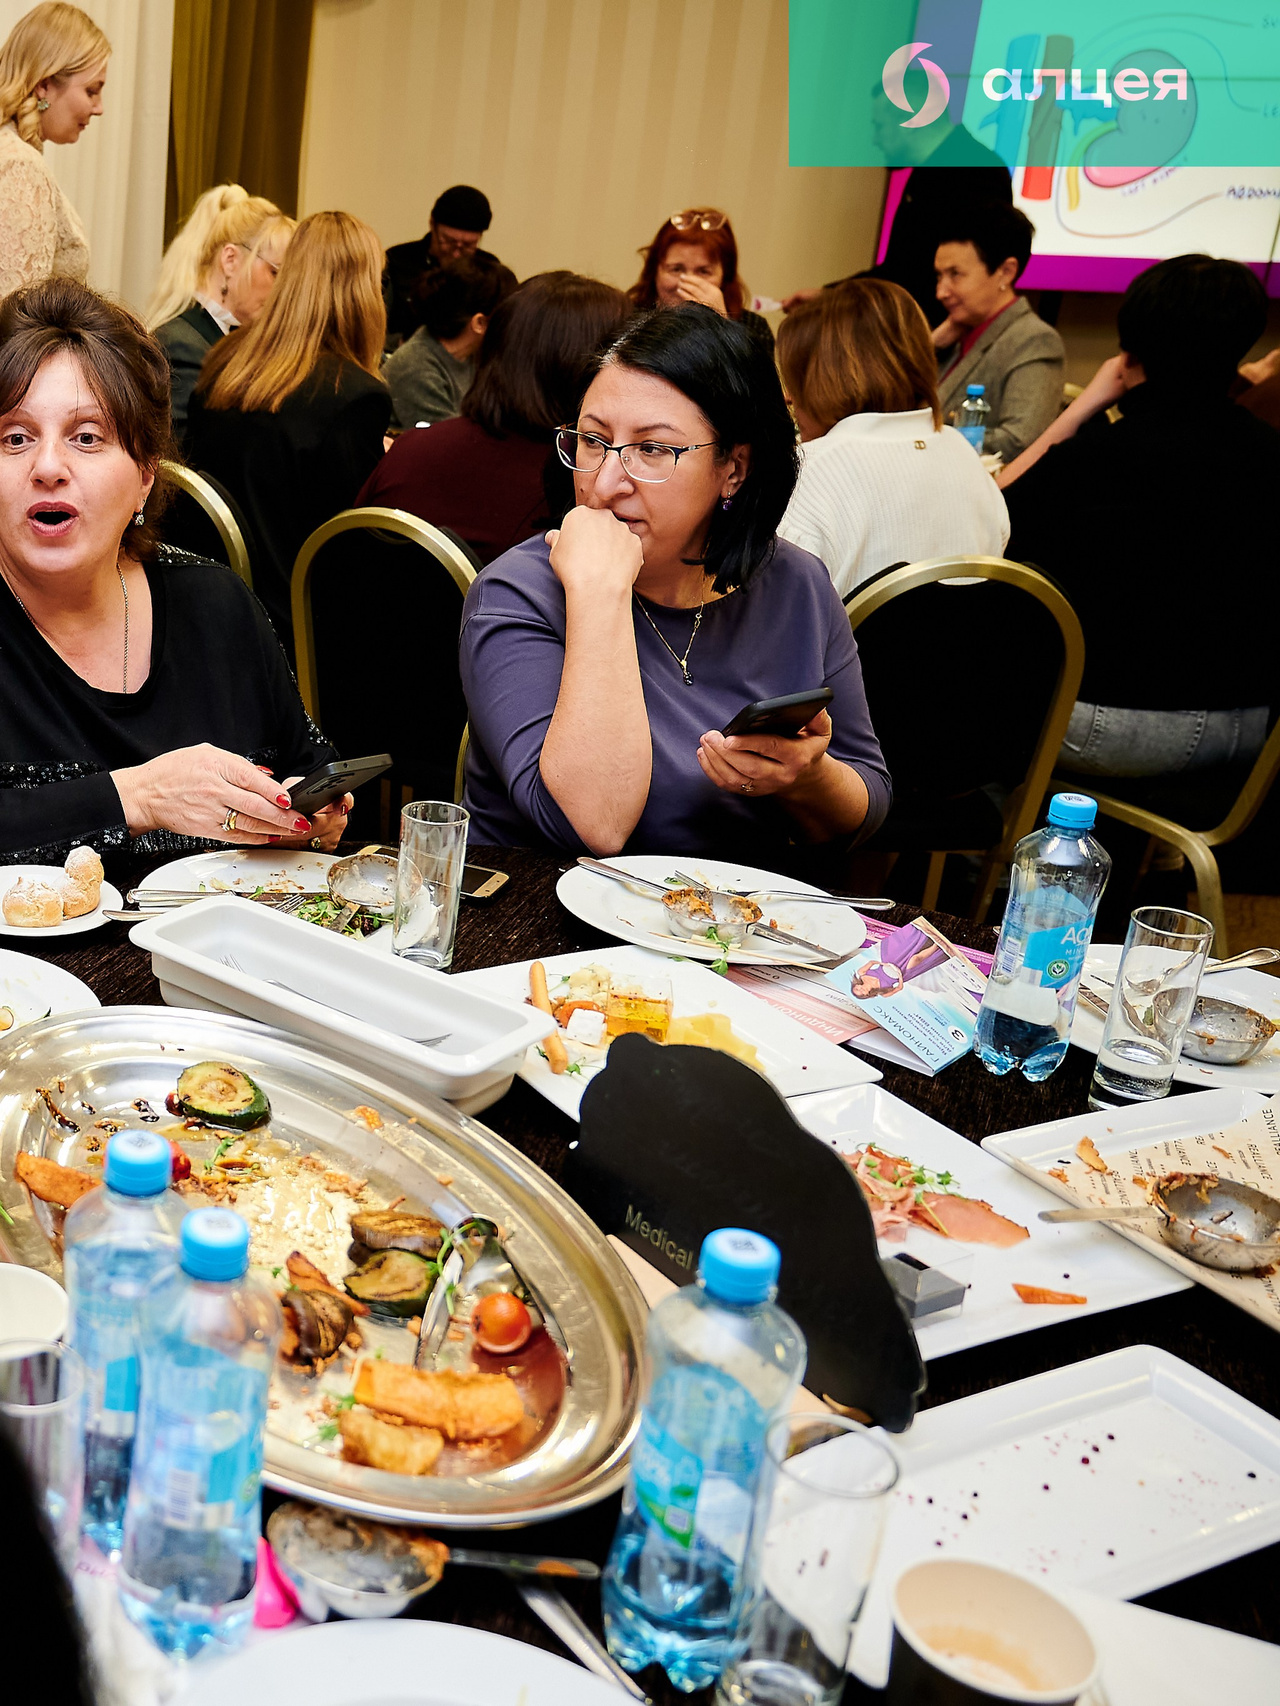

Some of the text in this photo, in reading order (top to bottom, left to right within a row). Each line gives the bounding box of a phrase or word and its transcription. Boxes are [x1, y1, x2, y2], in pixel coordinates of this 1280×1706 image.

[873, 1005, 940, 1063] ГАЙНОМАКС
[951, 1029, 964, 1041] 3
[625, 1204, 694, 1270] Medical
